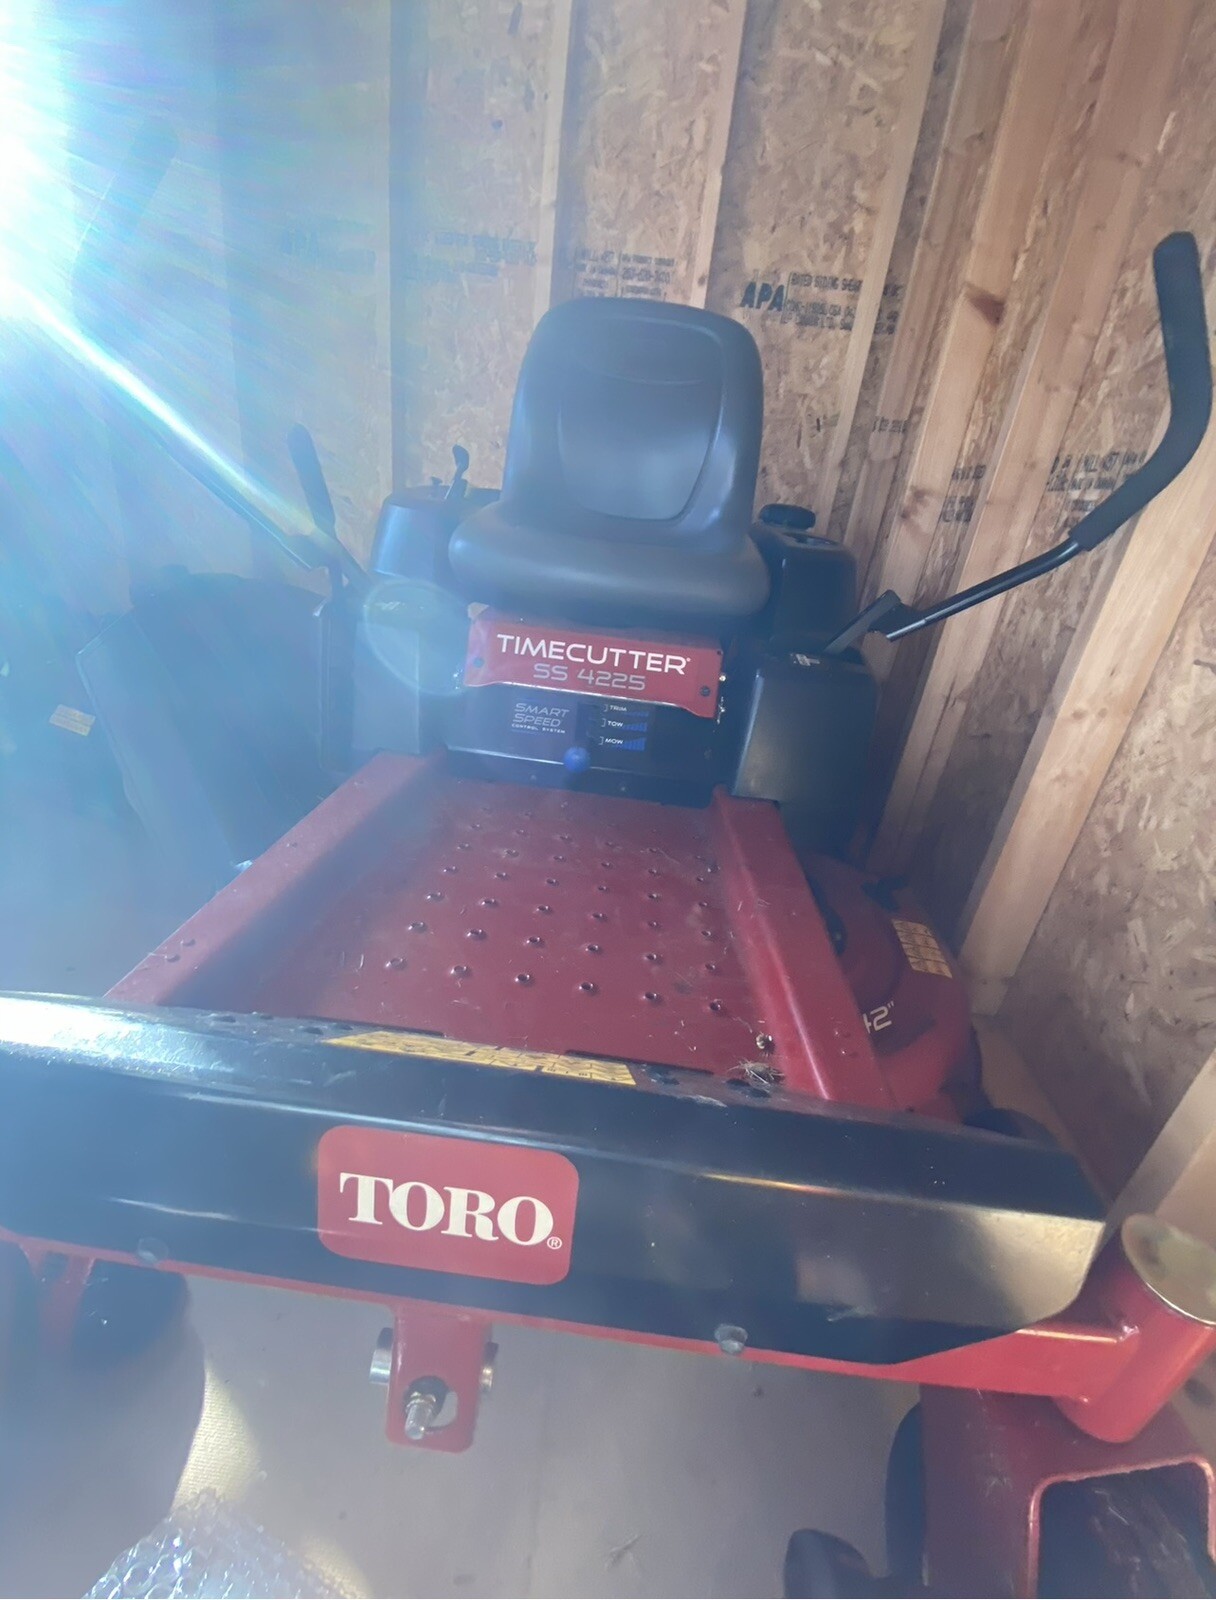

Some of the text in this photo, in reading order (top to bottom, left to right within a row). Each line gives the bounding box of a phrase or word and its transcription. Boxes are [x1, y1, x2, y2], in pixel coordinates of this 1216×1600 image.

[739, 281, 785, 312] APA
[497, 633, 687, 675] TIMECUTTER
[533, 663, 645, 691] SS 4225
[514, 702, 570, 718] SMART
[609, 704, 628, 712] TRIM
[511, 723, 539, 732] CONTROL
[513, 713, 561, 728] SPEED
[607, 720, 624, 728] TOW
[339, 1172, 554, 1246] TORO
